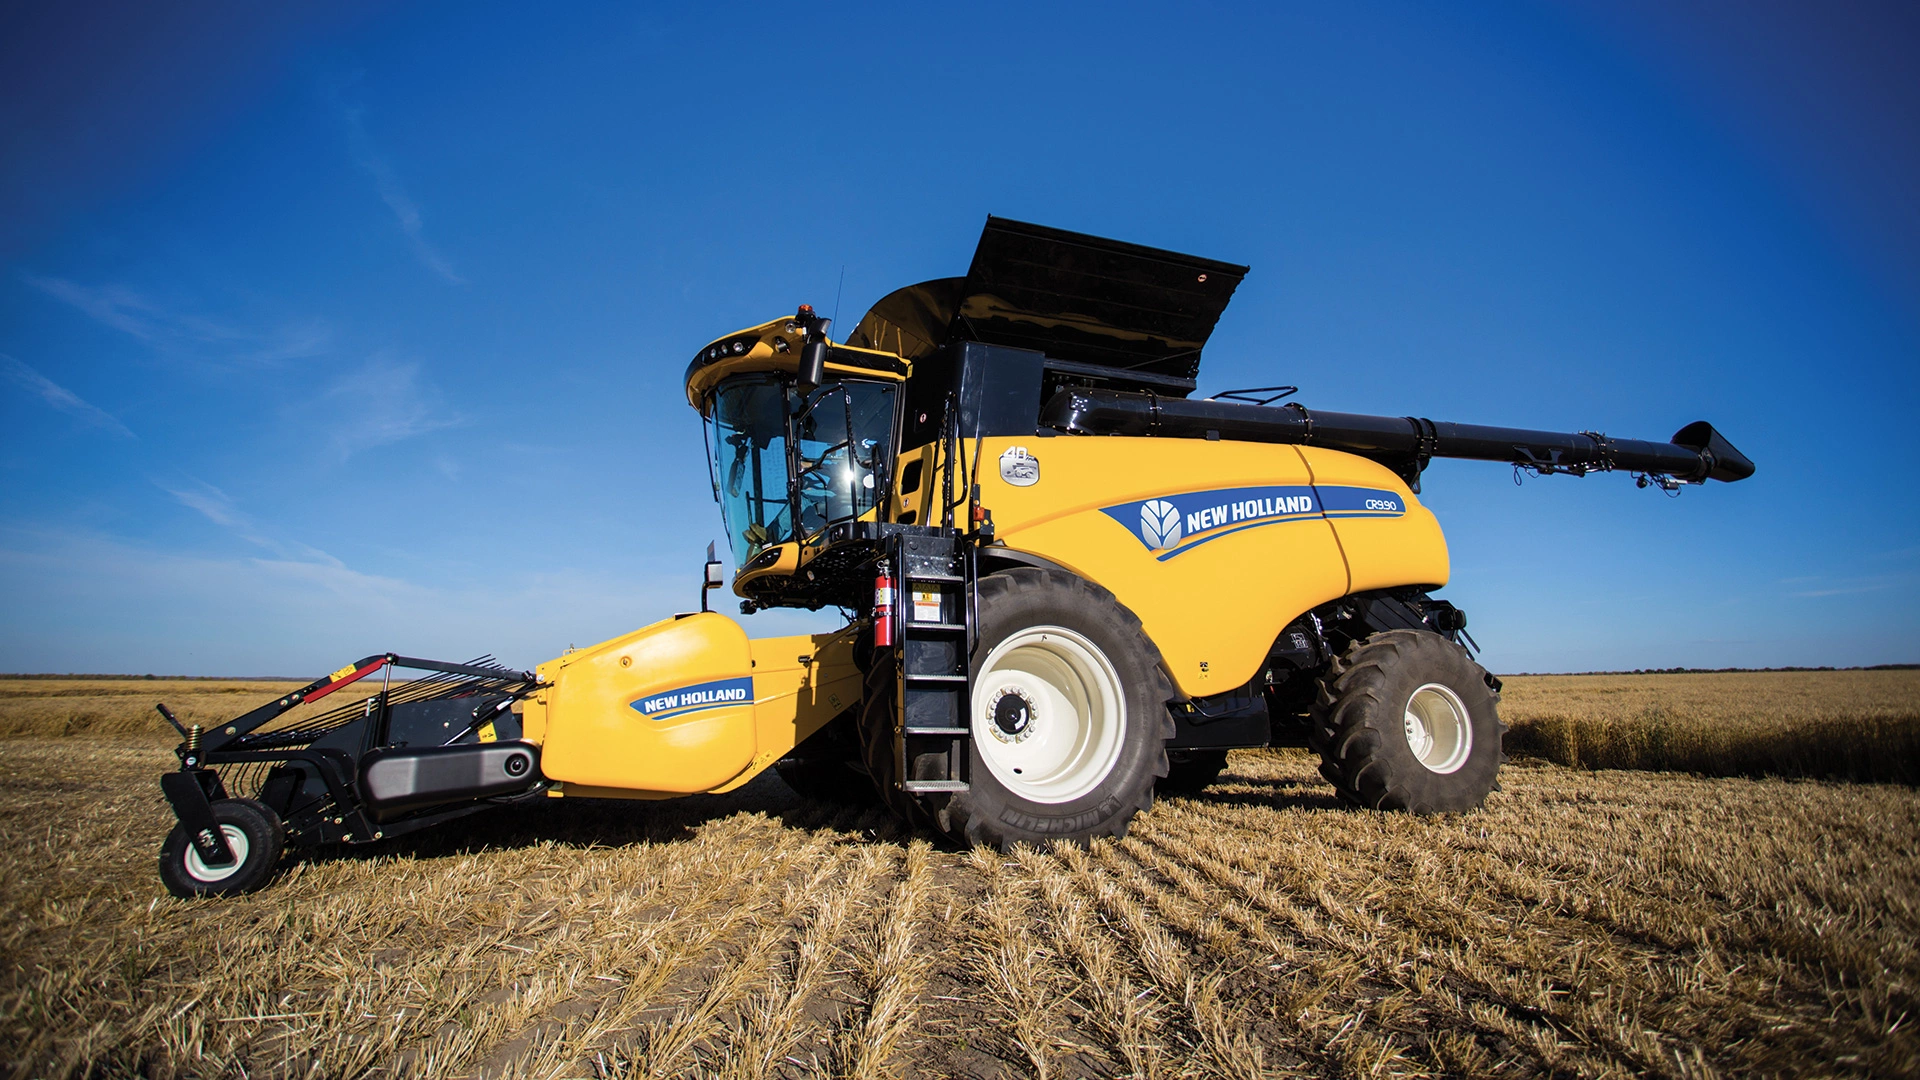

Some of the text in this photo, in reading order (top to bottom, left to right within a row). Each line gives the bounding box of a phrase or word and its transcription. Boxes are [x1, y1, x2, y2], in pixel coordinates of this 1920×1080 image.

[1187, 496, 1312, 534] NEW HOLLAND
[645, 688, 746, 713] NEW HOLLAND
[1000, 807, 1100, 833] MICHELIN
